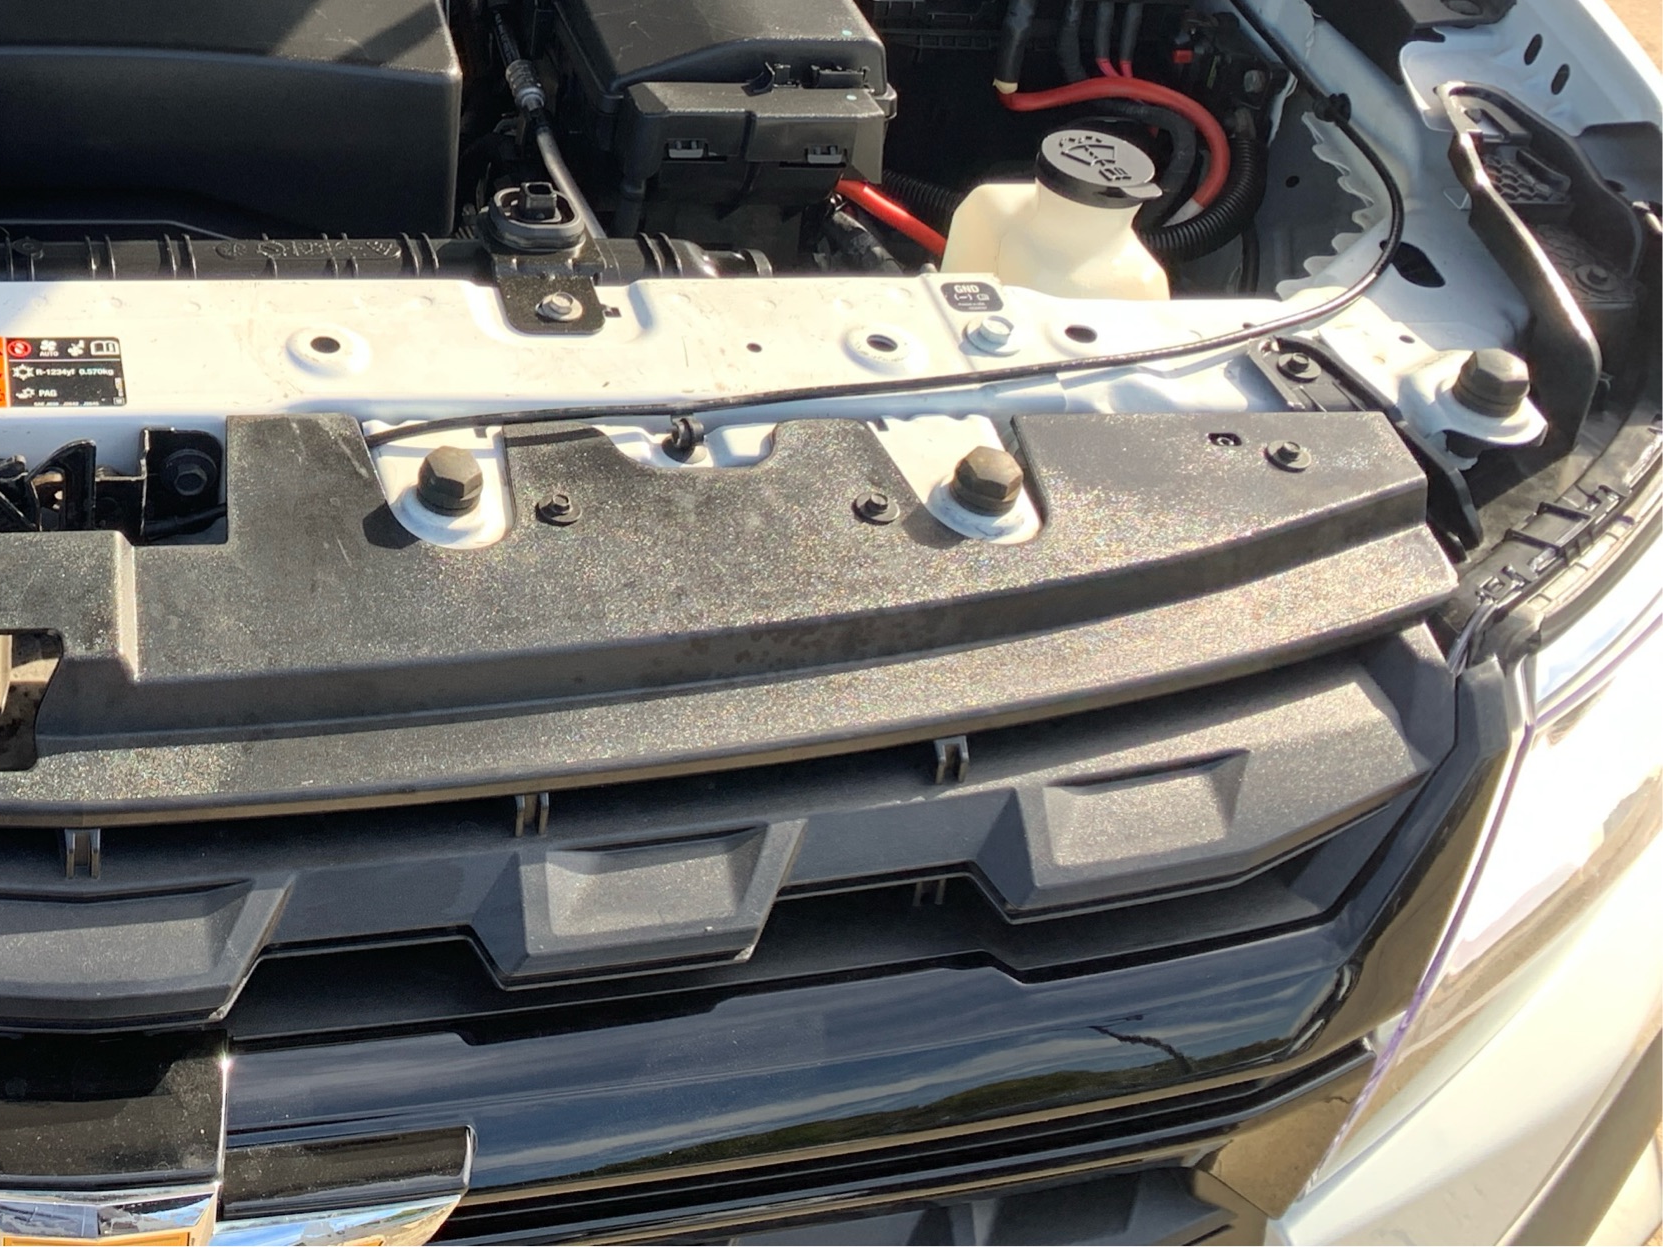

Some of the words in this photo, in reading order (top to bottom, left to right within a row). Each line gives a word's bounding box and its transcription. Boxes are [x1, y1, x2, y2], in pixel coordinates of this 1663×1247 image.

[954, 284, 980, 294] GND
[35, 368, 75, 377] R-1234yf
[38, 389, 58, 397] PAG
